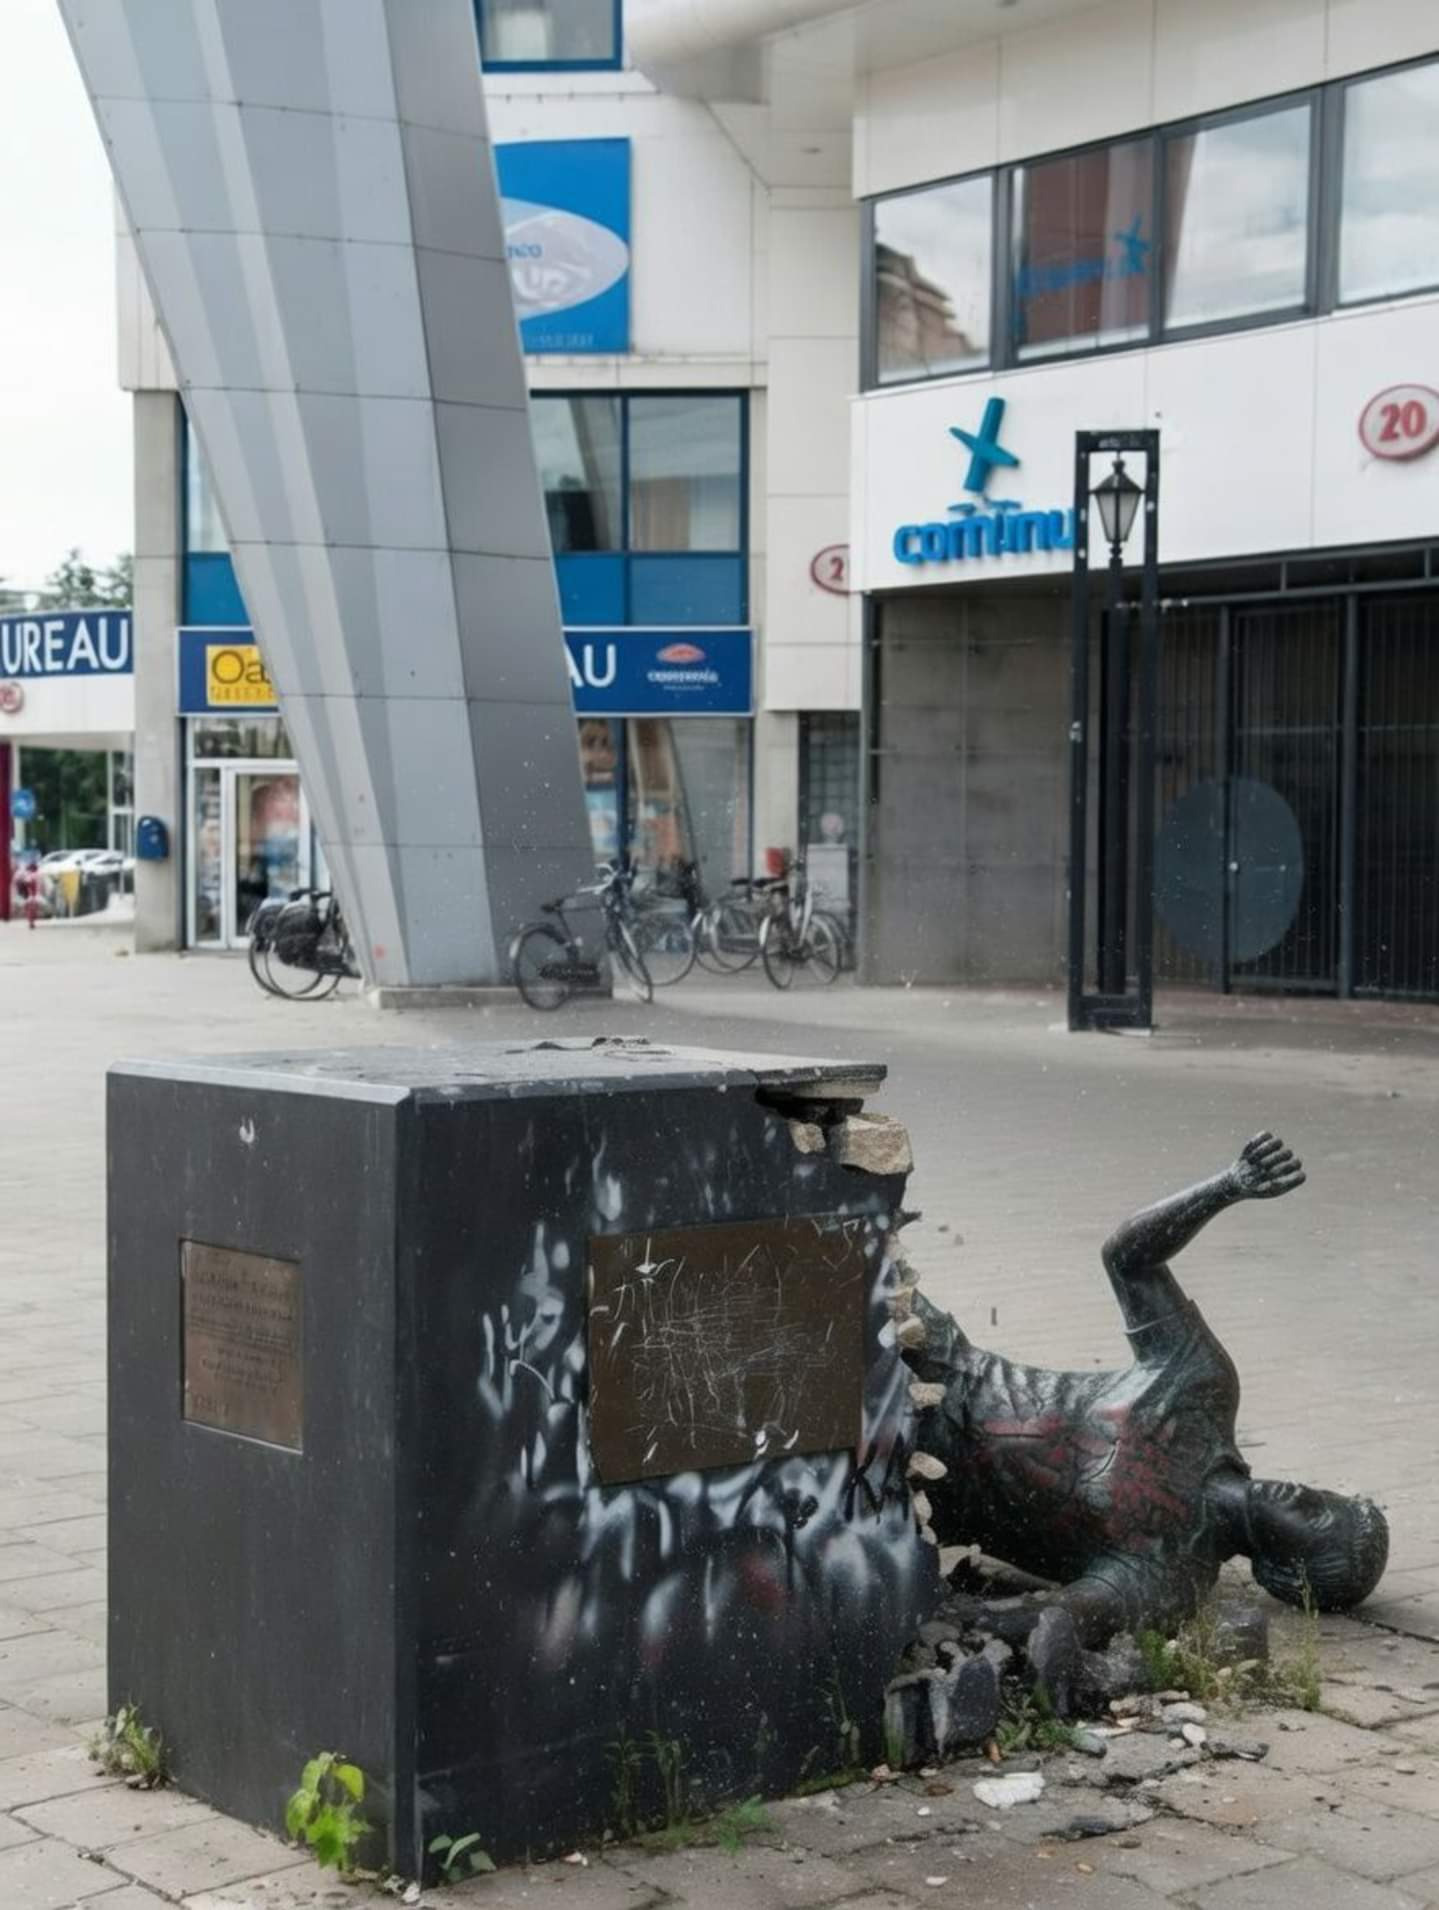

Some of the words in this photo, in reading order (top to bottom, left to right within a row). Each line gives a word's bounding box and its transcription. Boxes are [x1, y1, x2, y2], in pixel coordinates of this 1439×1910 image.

[1379, 400, 1427, 442] 20
[829, 556, 845, 582] 2
[2, 617, 128, 674] UREAU
